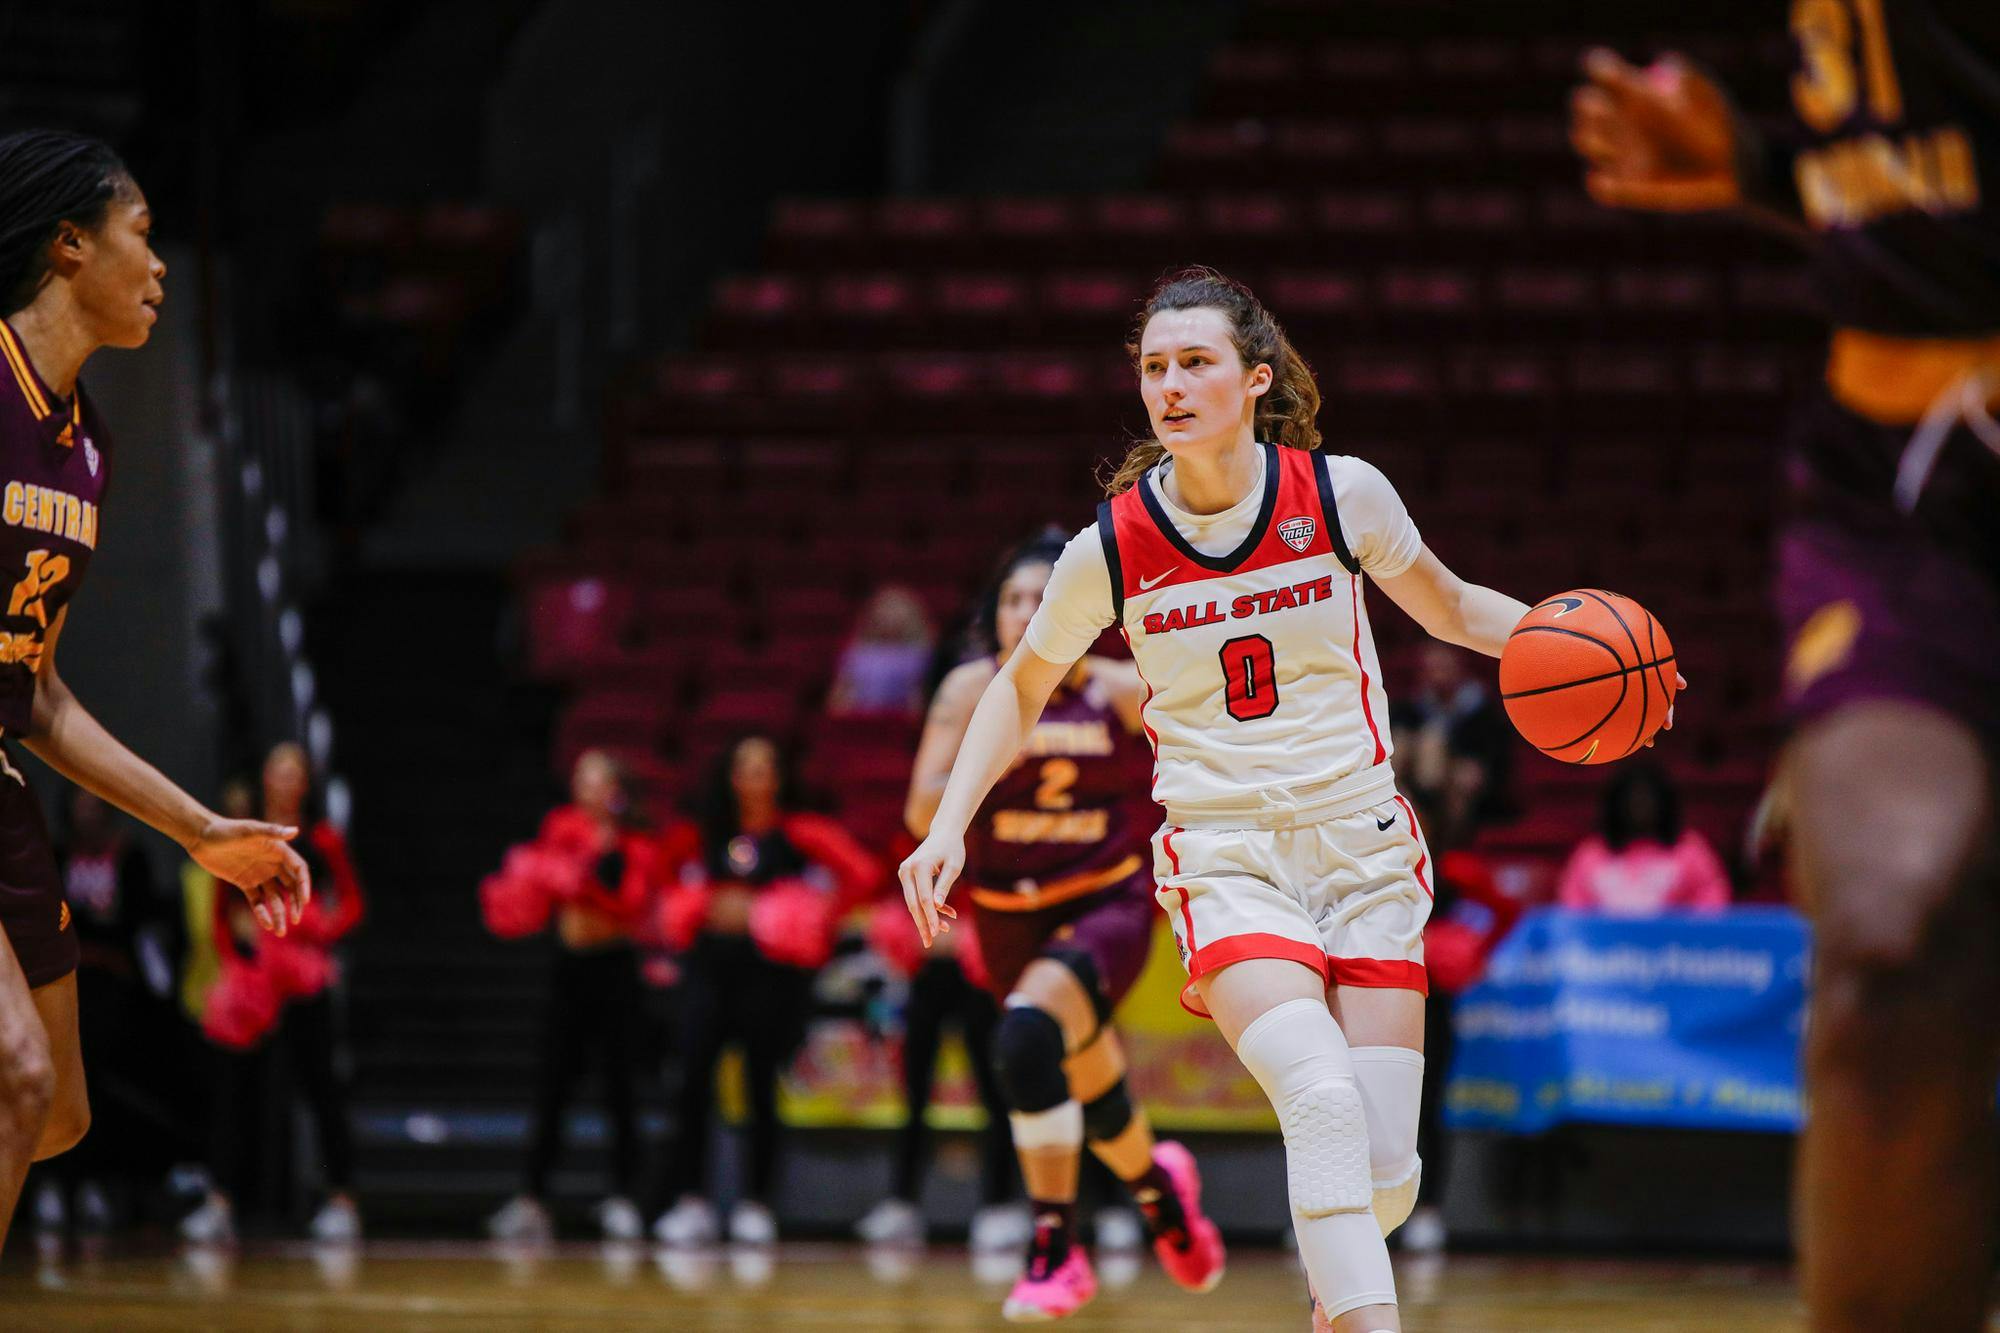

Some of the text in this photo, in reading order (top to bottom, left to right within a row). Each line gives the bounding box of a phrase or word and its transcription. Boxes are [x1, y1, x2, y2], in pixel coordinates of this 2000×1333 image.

[1282, 525, 1314, 540] MAC
[1142, 574, 1333, 635] BALL STATE
[1218, 633, 1280, 722] 0
[1033, 757, 1079, 811] 2
